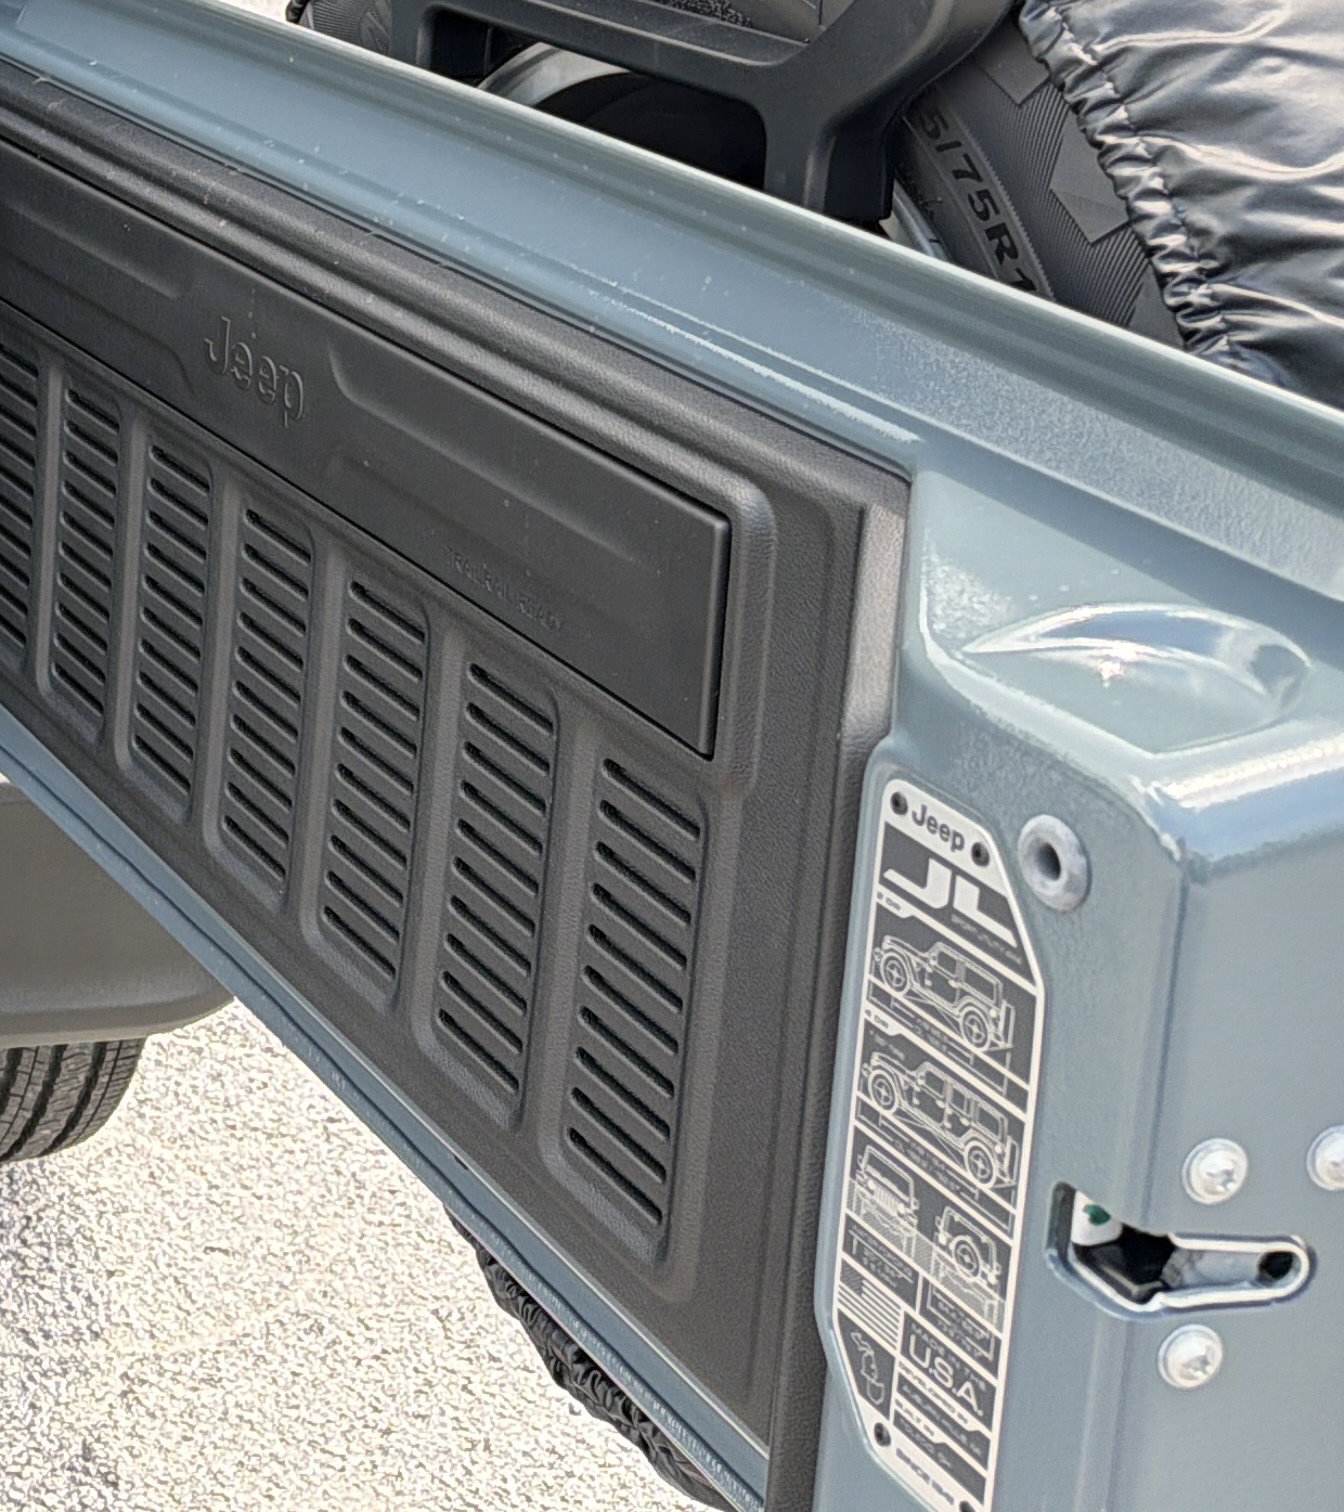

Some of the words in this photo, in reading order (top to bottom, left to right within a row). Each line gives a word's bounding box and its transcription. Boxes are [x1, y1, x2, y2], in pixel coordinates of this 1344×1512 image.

[204, 316, 304, 429] Jeep
[912, 804, 965, 852] Jeep
[883, 858, 1018, 948] JL
[909, 1334, 984, 1417] U.S.A.
[911, 1323, 945, 1356] MADE
